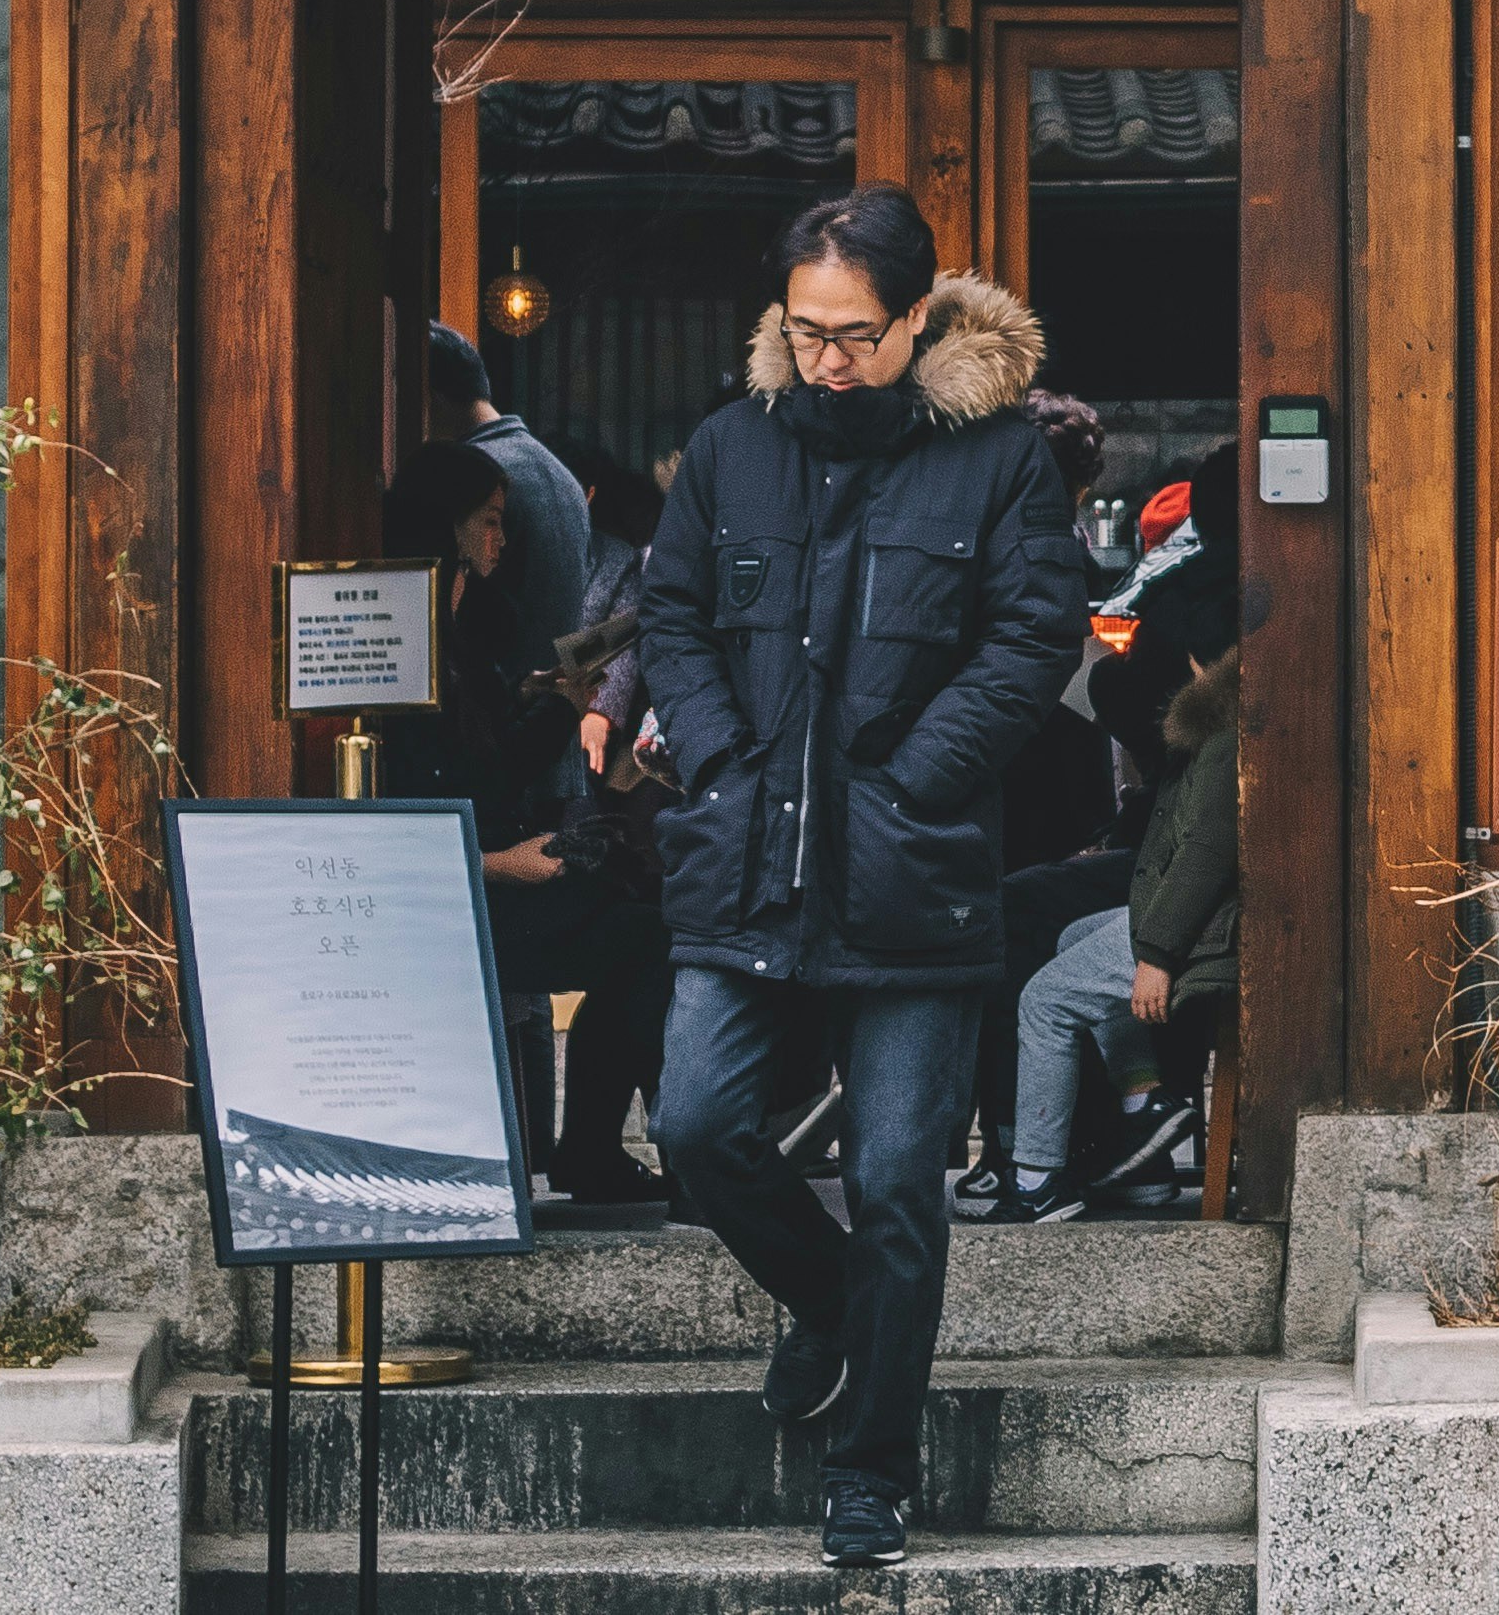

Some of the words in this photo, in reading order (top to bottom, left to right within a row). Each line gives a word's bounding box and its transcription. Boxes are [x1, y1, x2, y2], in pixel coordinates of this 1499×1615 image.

[295, 856, 360, 879] 익선동
[289, 895, 376, 918] 호호식당
[317, 935, 359, 956] 오픈
